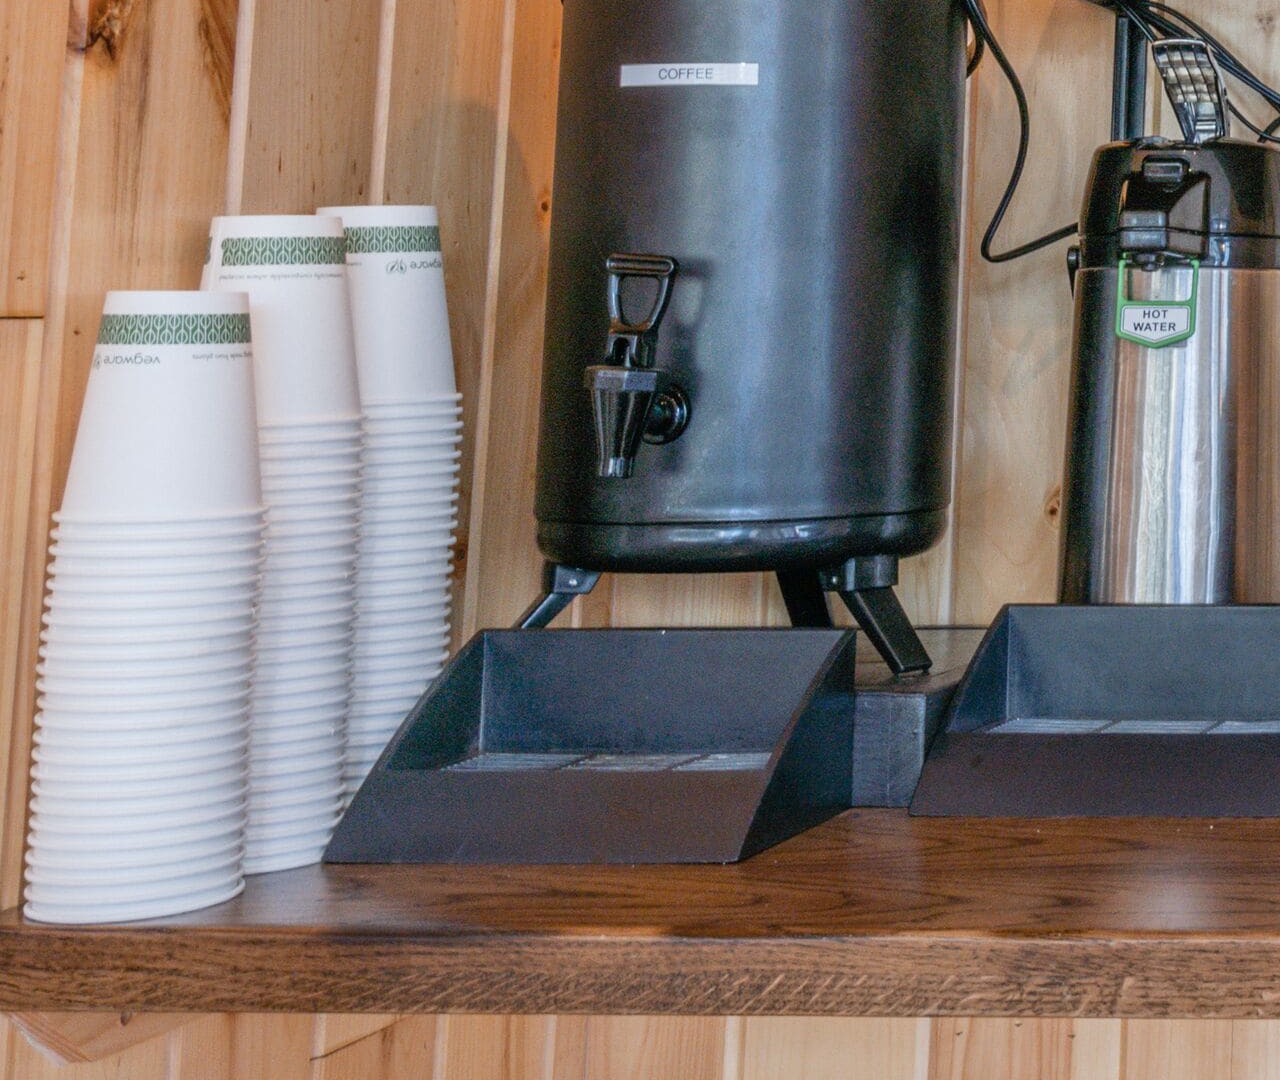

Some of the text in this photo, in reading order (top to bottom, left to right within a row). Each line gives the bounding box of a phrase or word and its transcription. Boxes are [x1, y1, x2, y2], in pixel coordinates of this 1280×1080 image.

[658, 68, 713, 81] COFFEE
[1142, 309, 1169, 319] HOT
[1133, 322, 1177, 332] WATER
[103, 352, 161, 368] vegware
